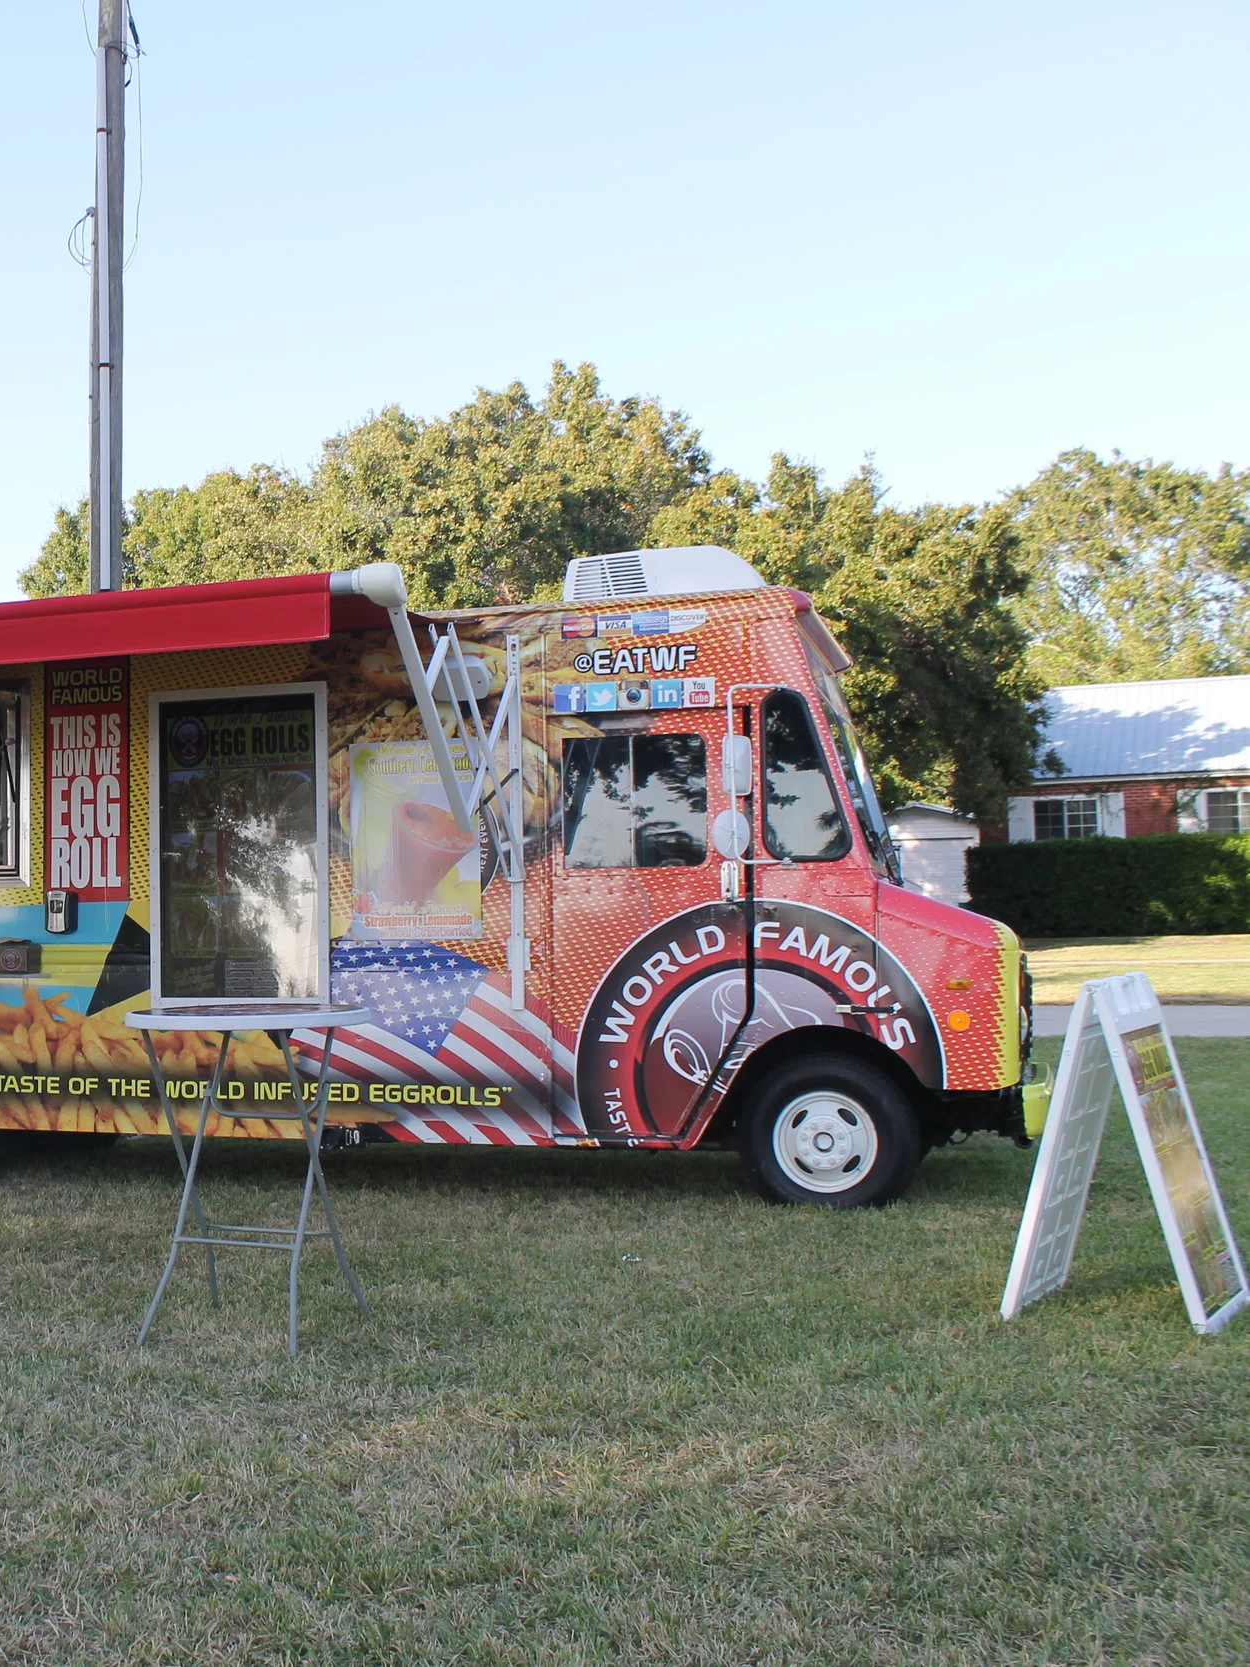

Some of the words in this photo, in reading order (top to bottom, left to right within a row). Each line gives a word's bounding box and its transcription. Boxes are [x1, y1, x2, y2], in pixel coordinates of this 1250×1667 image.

[605, 620, 626, 630] VISA
[670, 613, 705, 622] DISCOVER
[574, 644, 698, 676] @EATWF
[52, 667, 122, 688] WORLD
[692, 680, 706, 690] You
[52, 687, 122, 705] FAMOUS
[657, 683, 678, 703] in
[690, 692, 710, 704] Tube
[51, 714, 96, 749] THIS
[102, 713, 121, 748] IS
[210, 728, 246, 757] EGG
[252, 724, 310, 754] ROLLS
[52, 748, 91, 777] HOW
[94, 747, 120, 775] WE
[368, 757, 418, 776] Southern
[52, 775, 120, 838] EGG
[51, 837, 122, 889] ROLL
[364, 914, 418, 928] Strawberry
[423, 913, 473, 926] Lemonade
[598, 925, 726, 1044] WORLD
[754, 921, 917, 1050] FAMOUS
[68, 1076, 98, 1096] OF
[108, 1078, 150, 1098] THE
